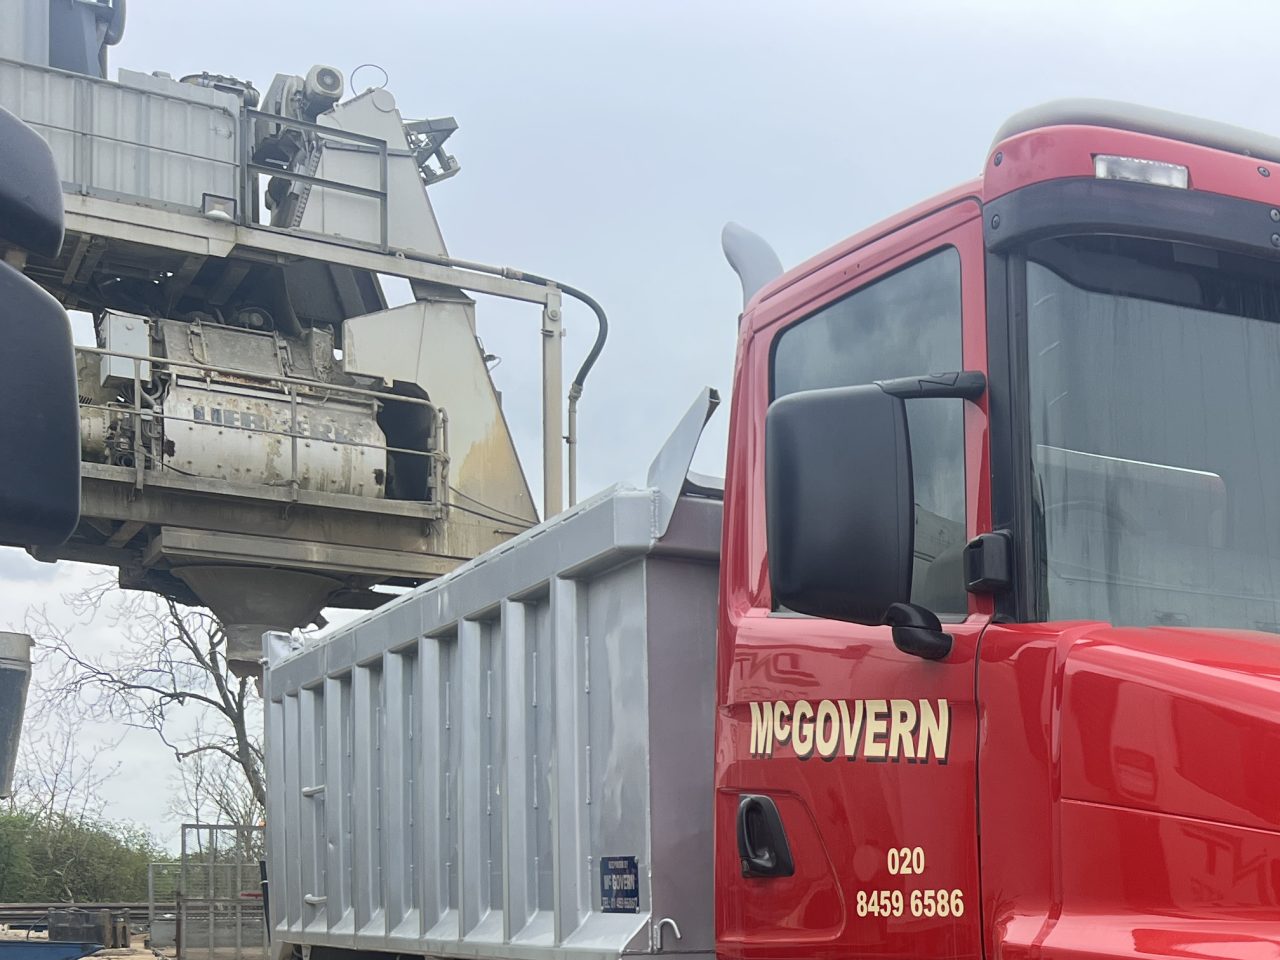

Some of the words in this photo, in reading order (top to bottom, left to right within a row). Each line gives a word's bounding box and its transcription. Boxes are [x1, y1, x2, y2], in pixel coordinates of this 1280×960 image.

[887, 846, 926, 875] 020
[856, 890, 904, 917] 8459
[910, 889, 964, 917] 6586
